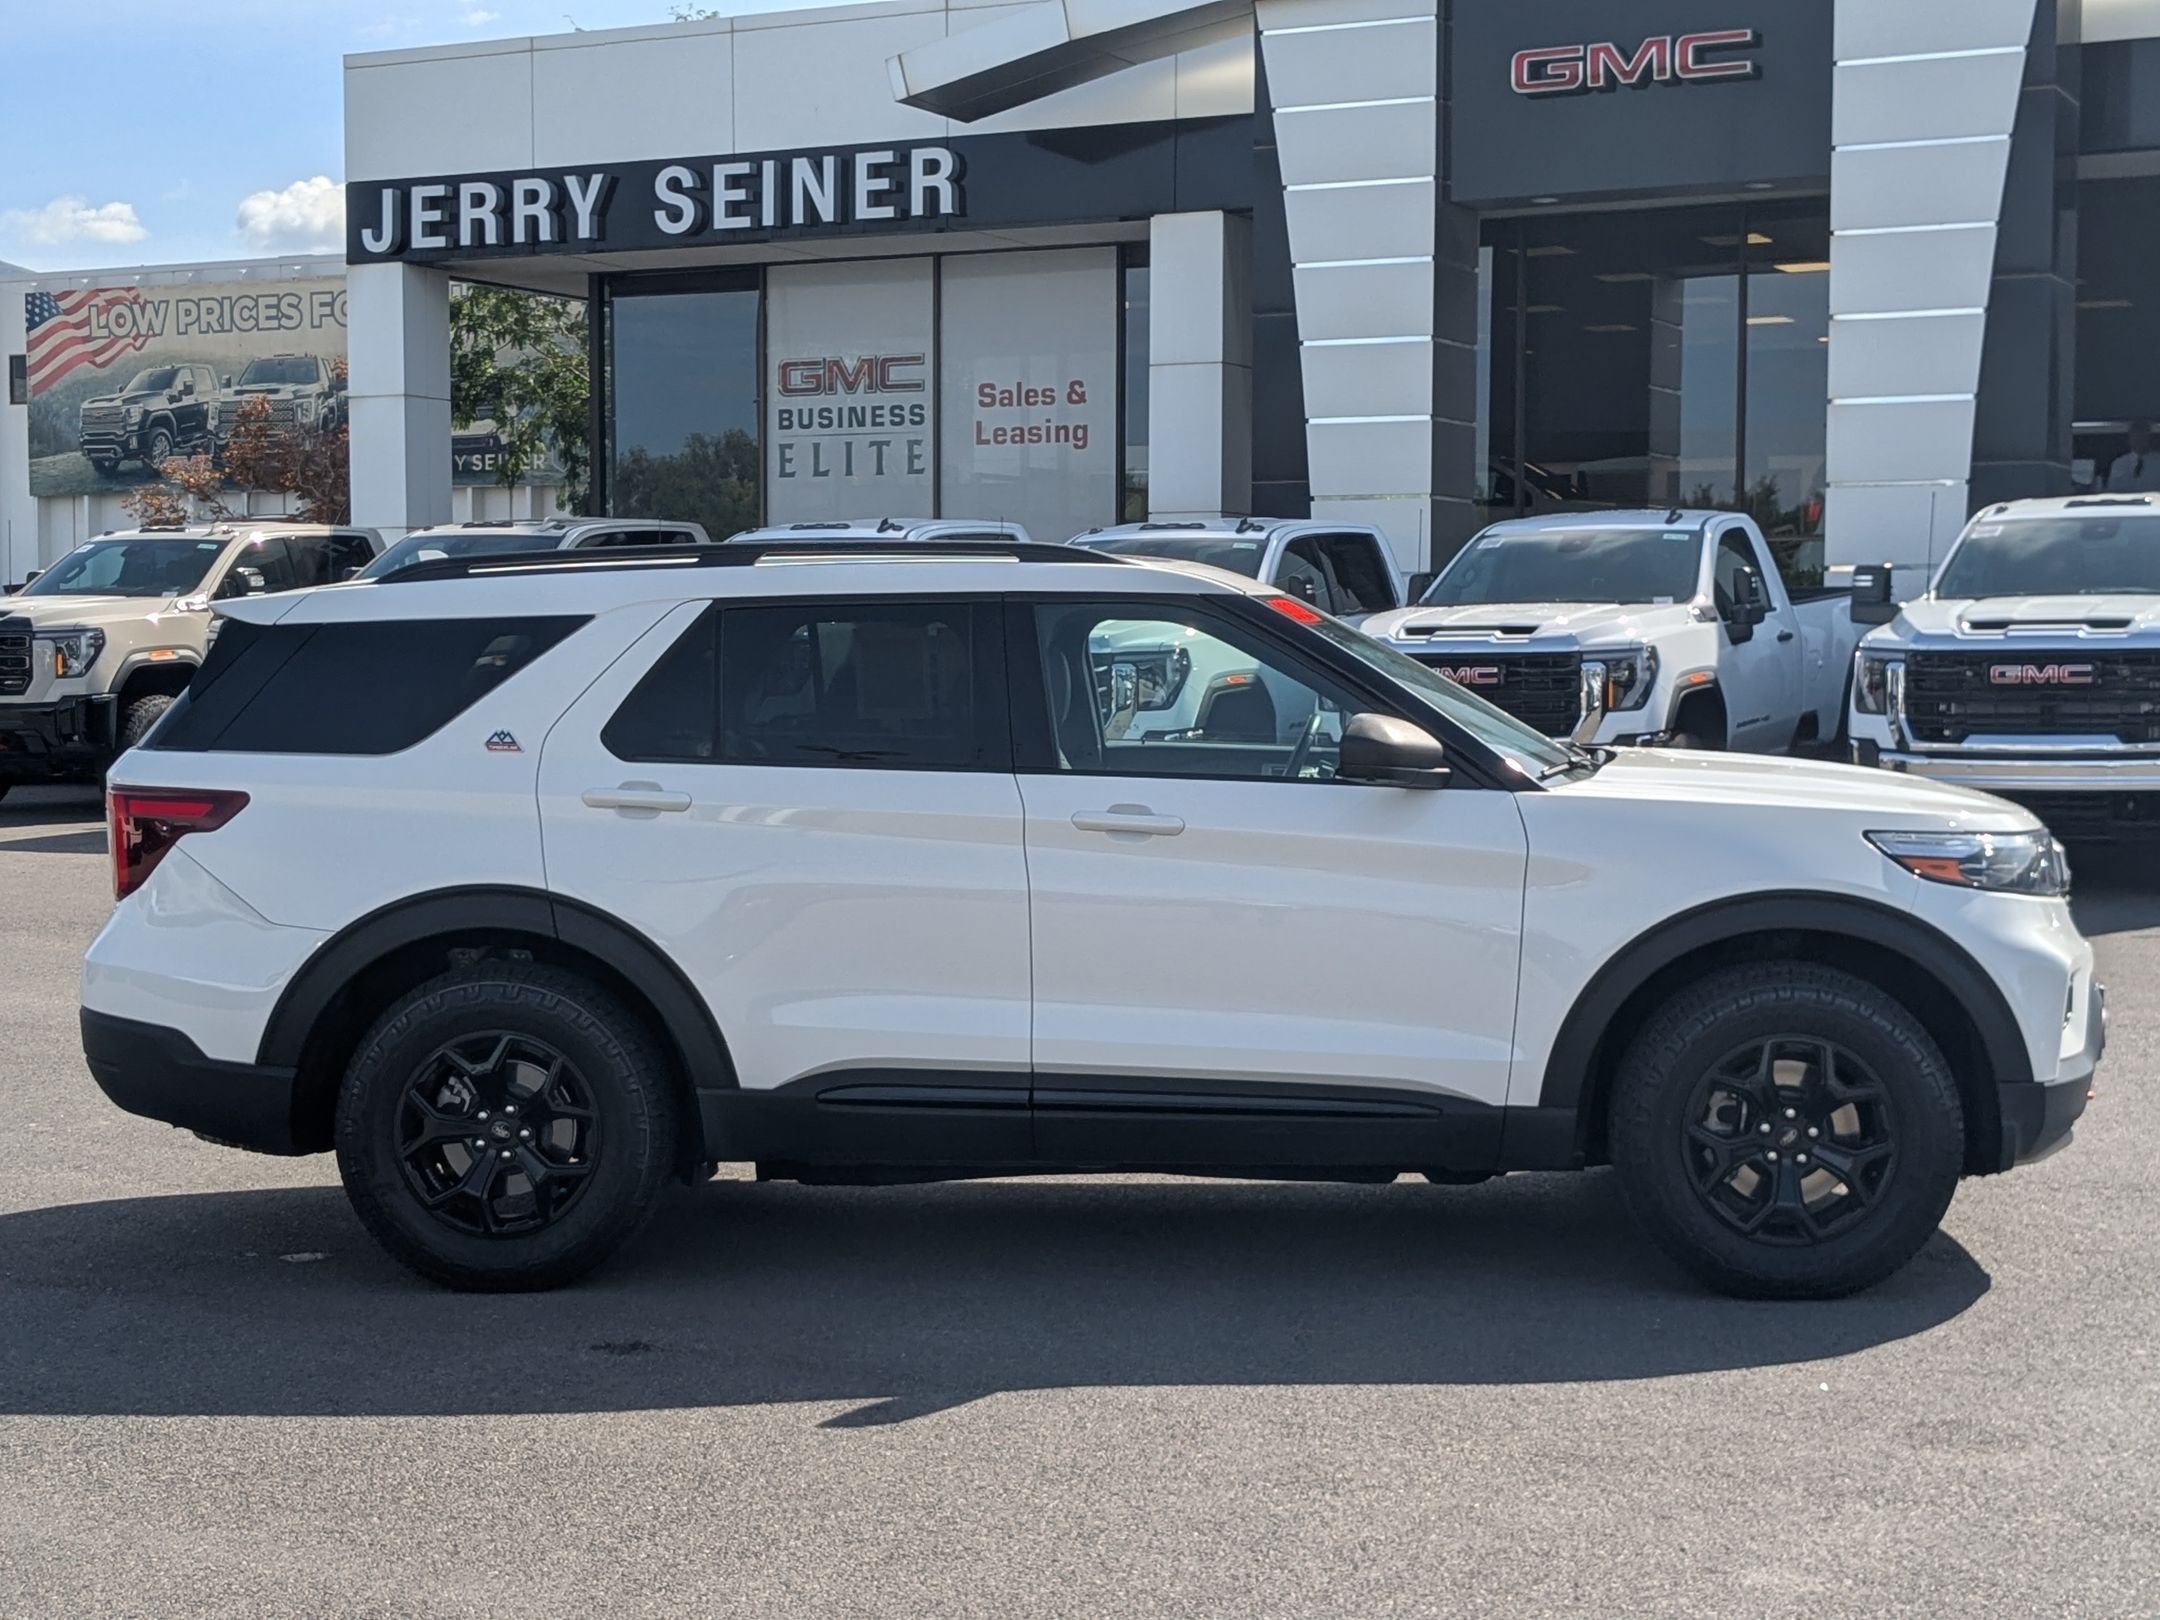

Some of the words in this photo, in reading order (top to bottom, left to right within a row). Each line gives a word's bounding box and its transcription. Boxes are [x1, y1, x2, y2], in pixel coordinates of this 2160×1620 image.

[1511, 29, 1752, 94] GMC
[361, 173, 606, 254] JERRY
[653, 146, 957, 235] SEINER
[88, 299, 169, 338] LOW
[176, 292, 303, 335] PRICES
[778, 353, 925, 396] GMC
[977, 381, 1056, 408] Sales
[1065, 379, 1087, 405] &
[777, 403, 926, 430] BUSINESS
[975, 418, 1089, 450] Leasing
[778, 438, 926, 478] ELITE
[1430, 666, 1499, 684] MC
[1990, 664, 2093, 684] GMC
